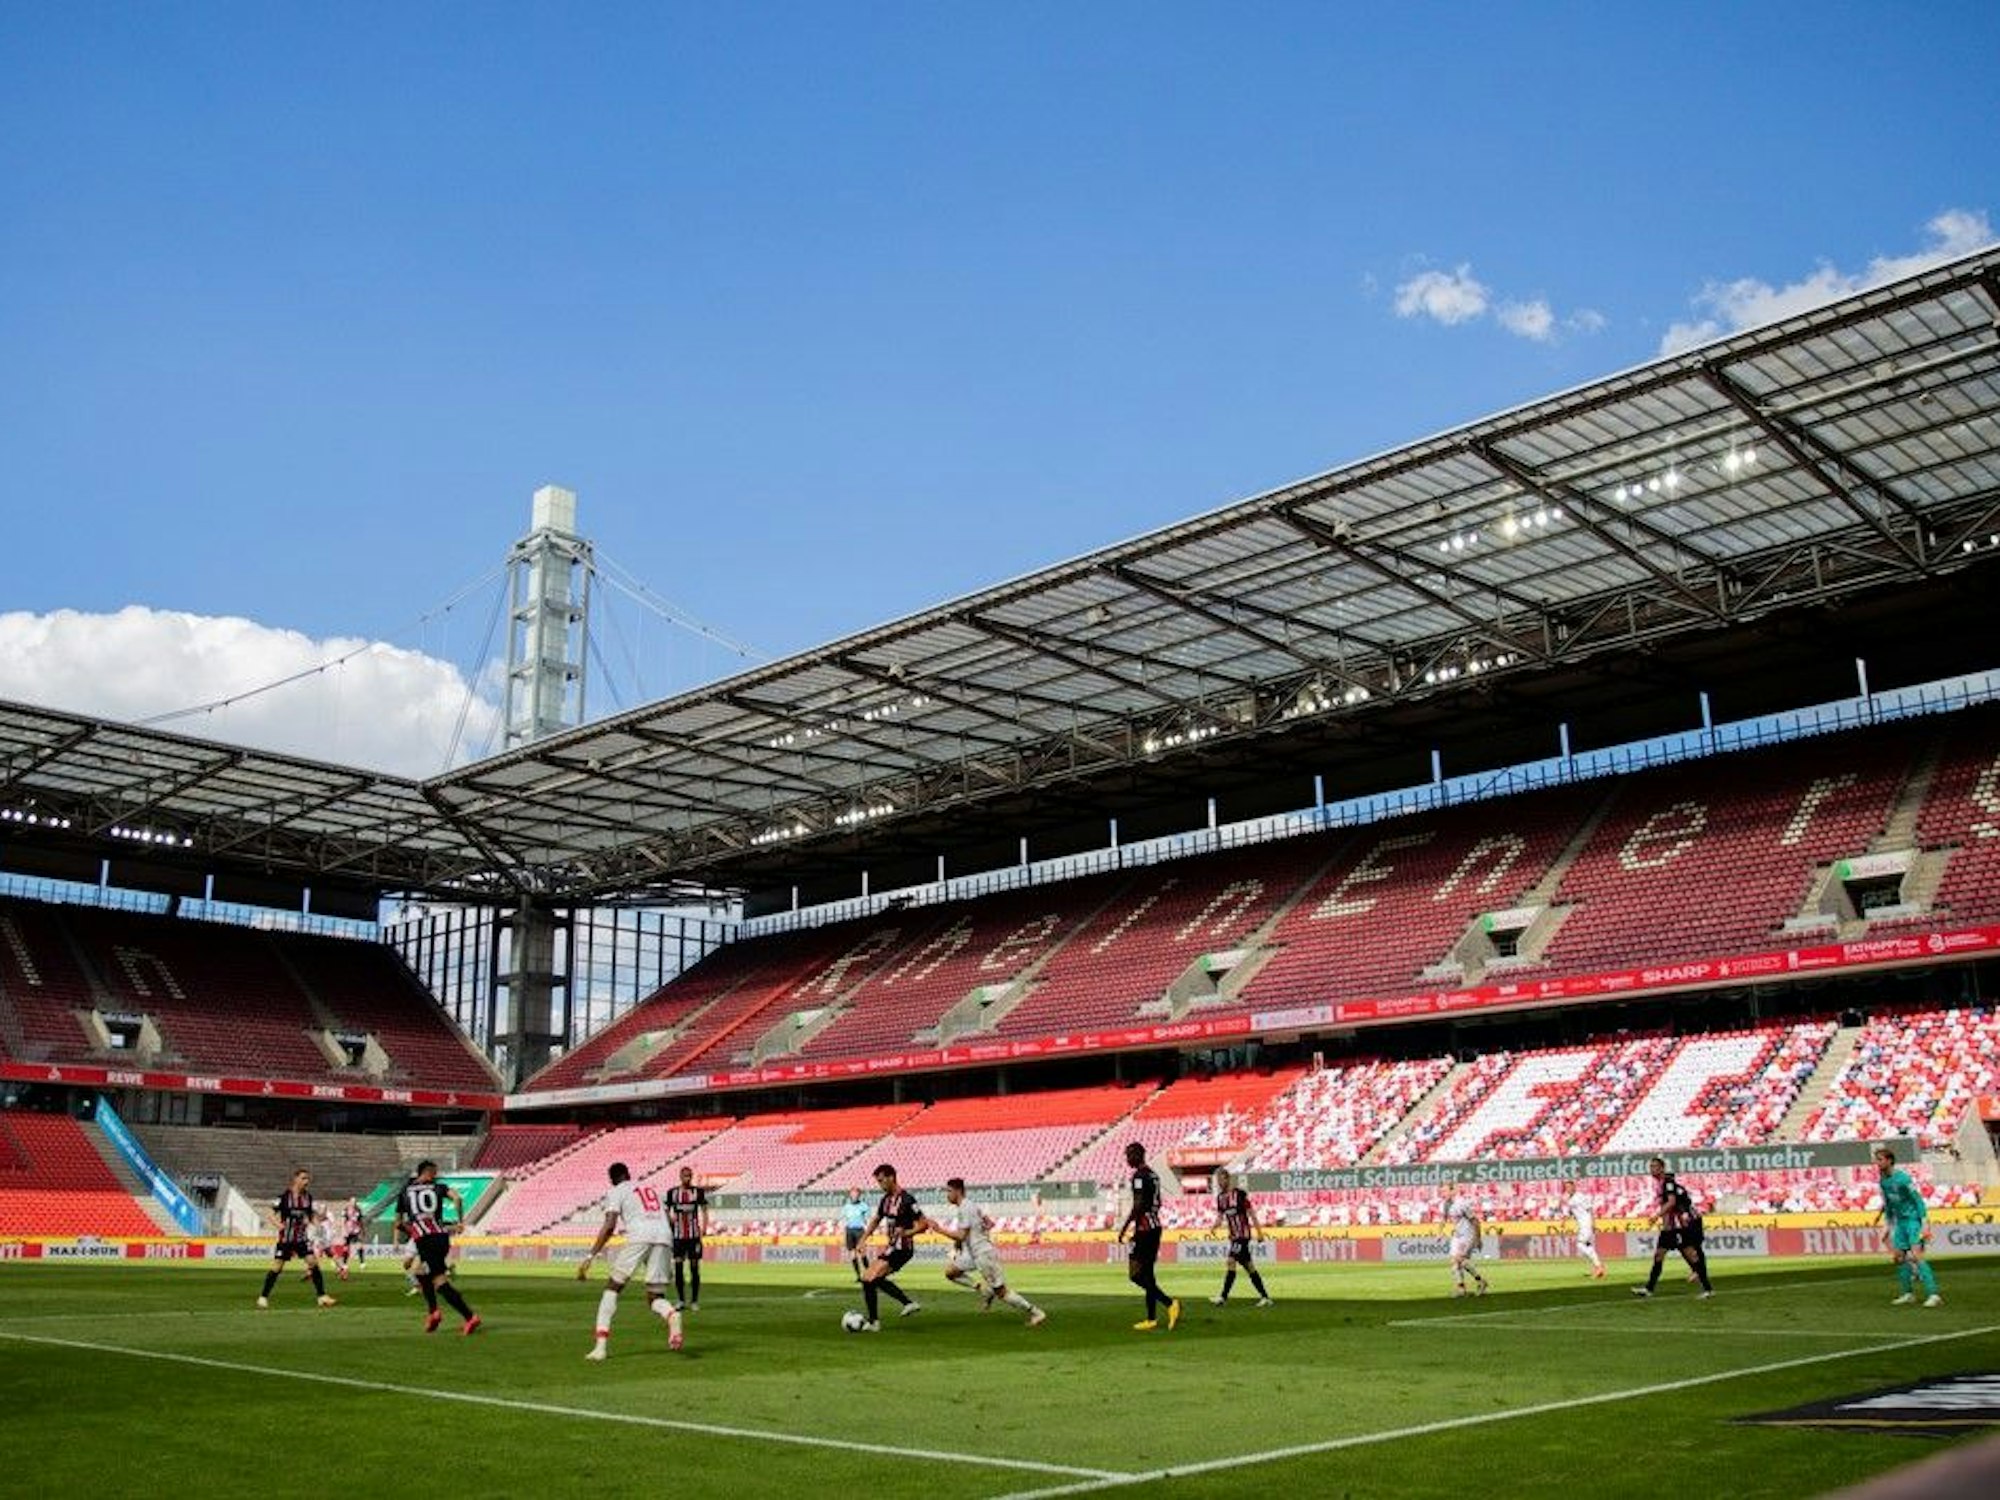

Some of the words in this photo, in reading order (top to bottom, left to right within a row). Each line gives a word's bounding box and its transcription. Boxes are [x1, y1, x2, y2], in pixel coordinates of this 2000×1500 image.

[1642, 964, 1710, 983] SHARP
[1153, 1024, 1201, 1039] SHARP
[106, 1071, 145, 1086] REWE
[186, 1076, 222, 1090] REWE
[311, 1085, 346, 1098] REWE
[1280, 1167, 1360, 1190] Bäckerei
[1364, 1164, 1462, 1187] Schneider
[1475, 1158, 1581, 1182] Schmeckt
[1678, 1148, 1740, 1171] nach
[1745, 1146, 1815, 1169] mehr
[407, 1188, 438, 1214] 10
[633, 1186, 661, 1212] 19
[1949, 1229, 2000, 1247] Getre
